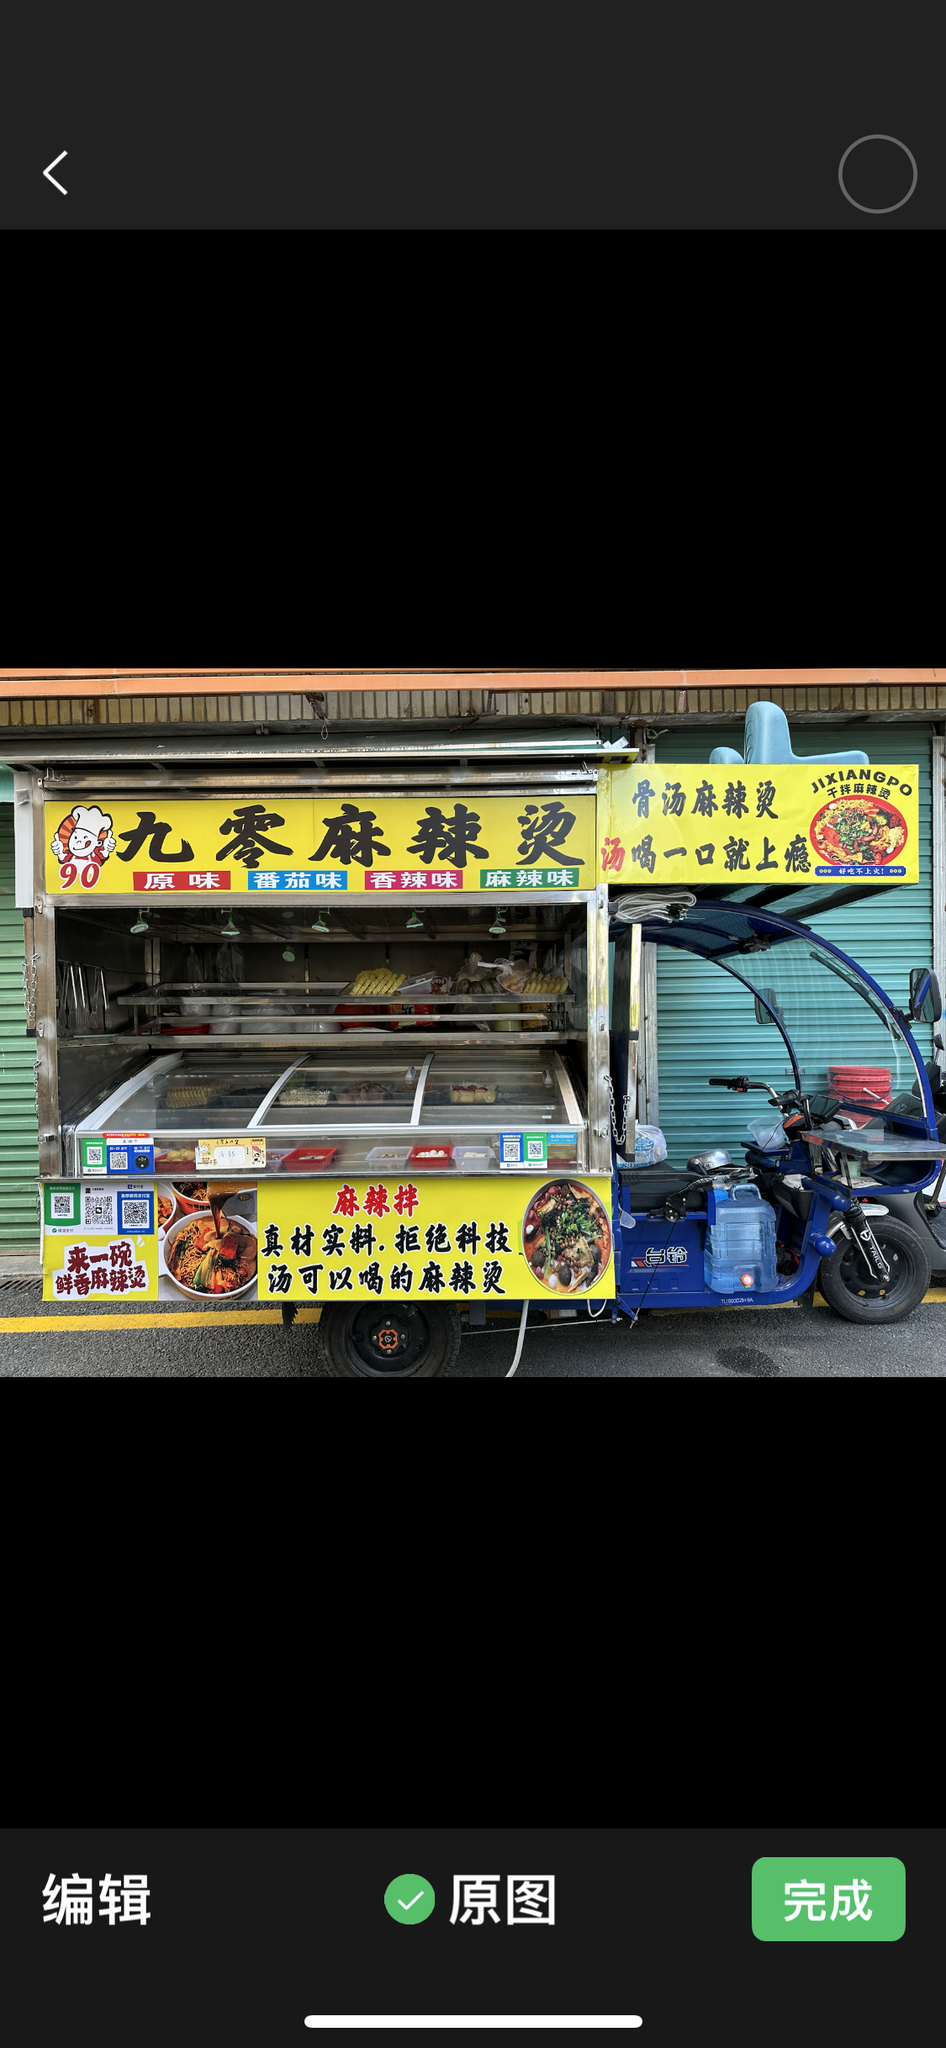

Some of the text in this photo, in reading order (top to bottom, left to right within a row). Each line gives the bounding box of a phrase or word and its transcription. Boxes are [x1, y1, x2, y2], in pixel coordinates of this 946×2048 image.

[811, 769, 912, 796] JIXIANGPO
[826, 783, 891, 800] 干拌麻辣烫
[632, 779, 779, 819] 骨汤麻辣烫
[116, 801, 585, 869] 九零麻辣烫
[600, 834, 812, 873] 汤喝一口就上瘾
[58, 862, 101, 890] 90
[143, 872, 221, 890] 原味
[253, 872, 342, 889] 番茄味
[370, 872, 458, 889] 香辣味
[485, 871, 574, 887] 麻辣味
[332, 1184, 420, 1218] 麻辣拌
[67, 1241, 133, 1273] 来一碗
[643, 1246, 688, 1267] 台铃
[55, 1264, 146, 1296] 鲜香麻辣烫
[268, 1261, 507, 1295] 汤可以喝的麻辣烫
